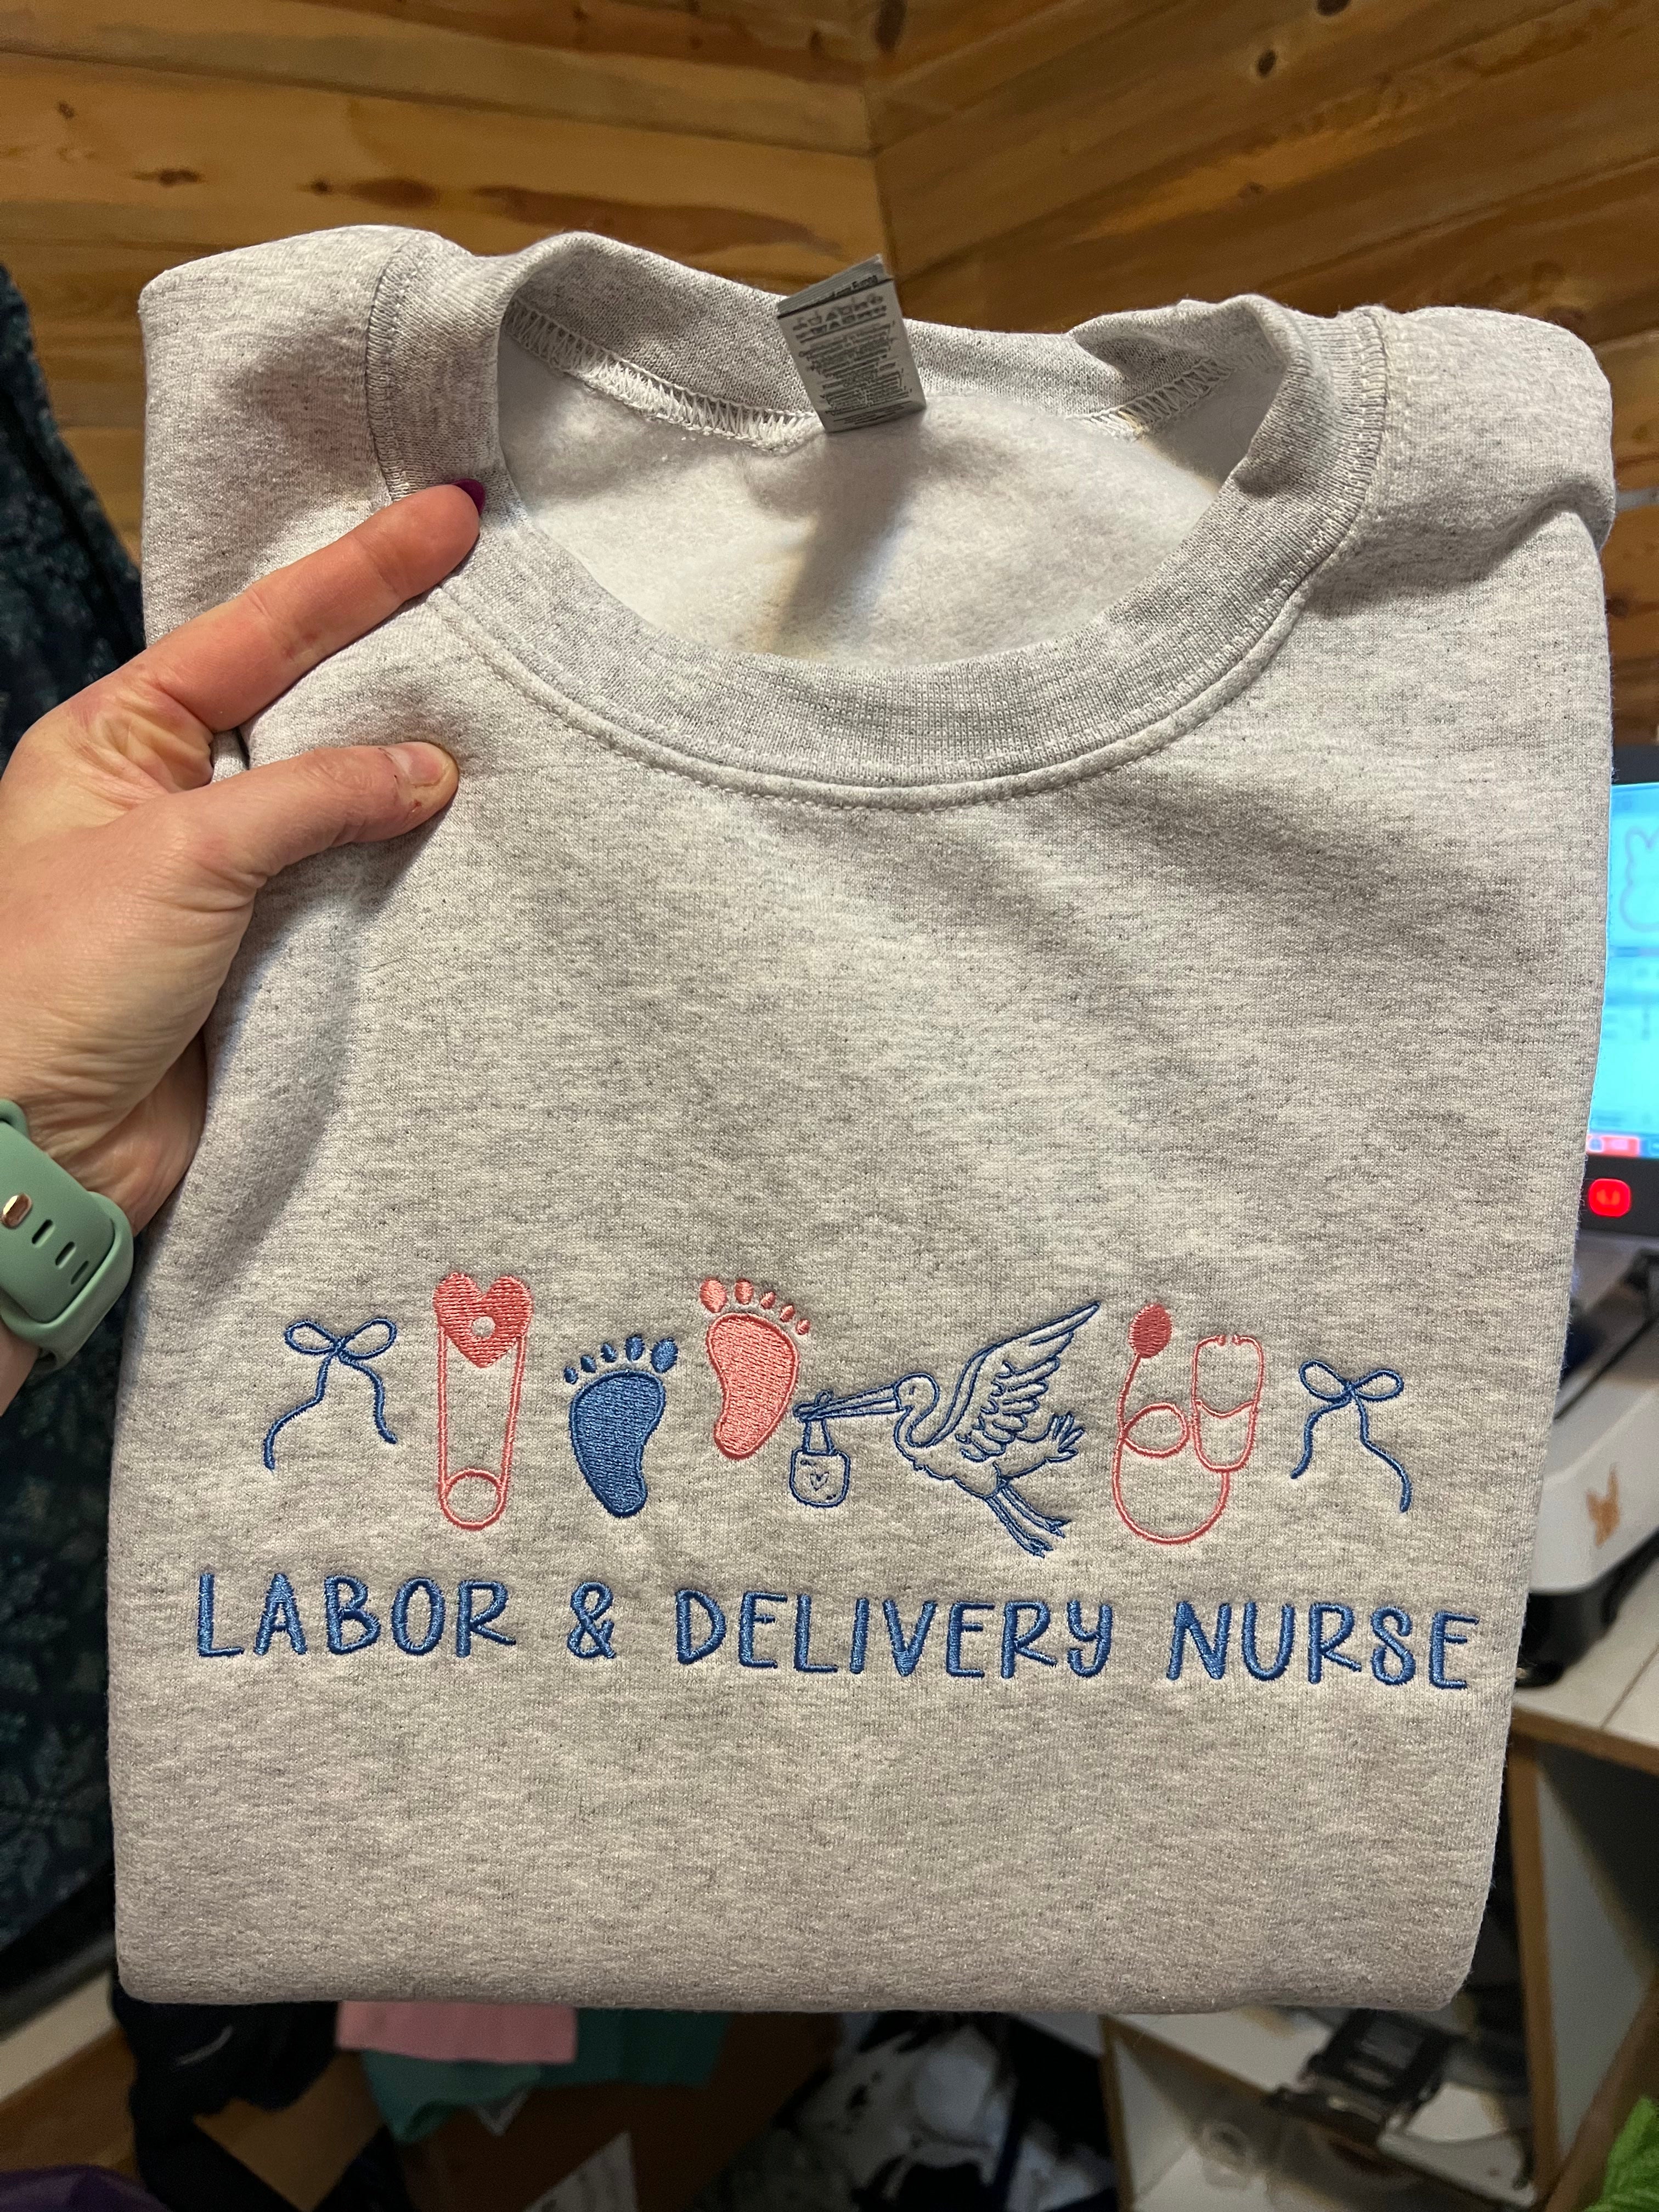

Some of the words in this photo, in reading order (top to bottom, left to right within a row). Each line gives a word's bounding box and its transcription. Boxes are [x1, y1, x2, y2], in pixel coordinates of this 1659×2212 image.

[196, 1573, 517, 1658] LABOR
[566, 1581, 616, 1660] &
[674, 1588, 1114, 1679] DELIVERY
[1166, 1600, 1480, 1690] NURSE
